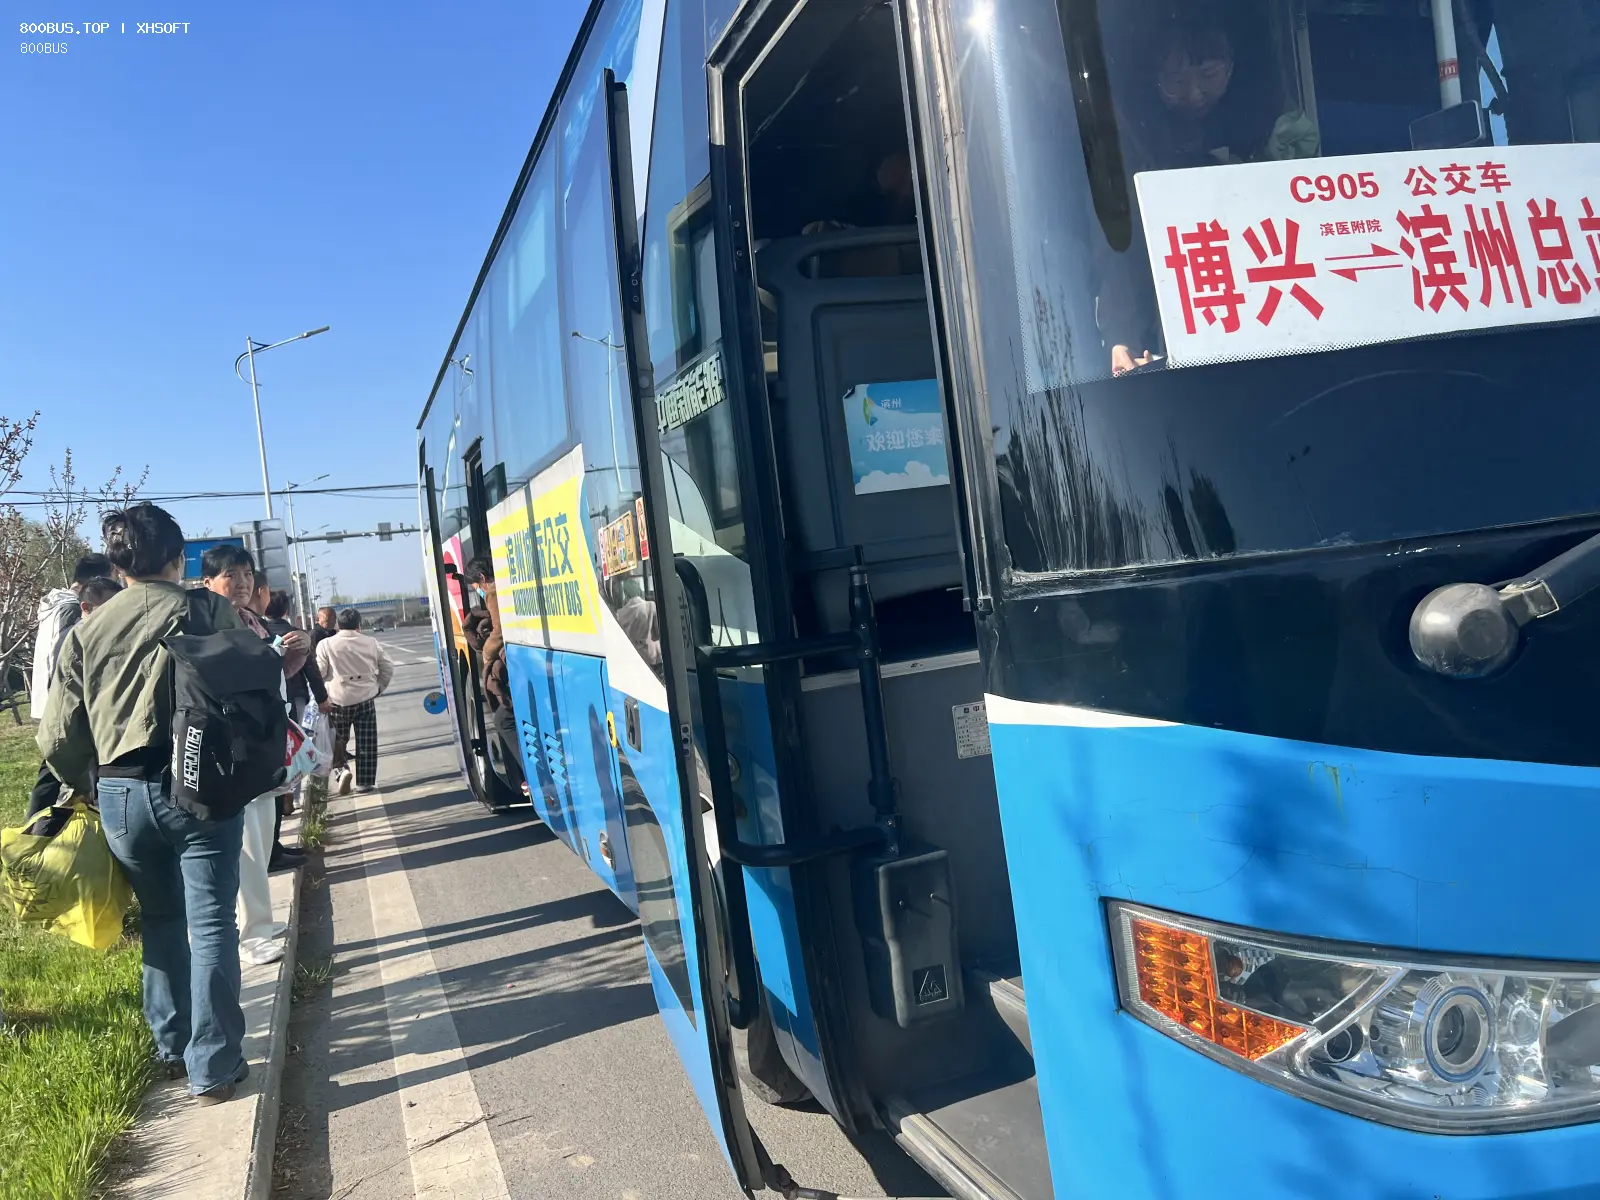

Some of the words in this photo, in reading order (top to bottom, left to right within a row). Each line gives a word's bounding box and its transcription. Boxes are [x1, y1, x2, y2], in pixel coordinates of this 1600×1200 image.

[1290, 172, 1380, 203] C905
[1404, 161, 1512, 197] 公交车
[1319, 218, 1383, 237] 滨医附院
[1164, 217, 1325, 335] 博兴
[564, 580, 583, 616] BUS
